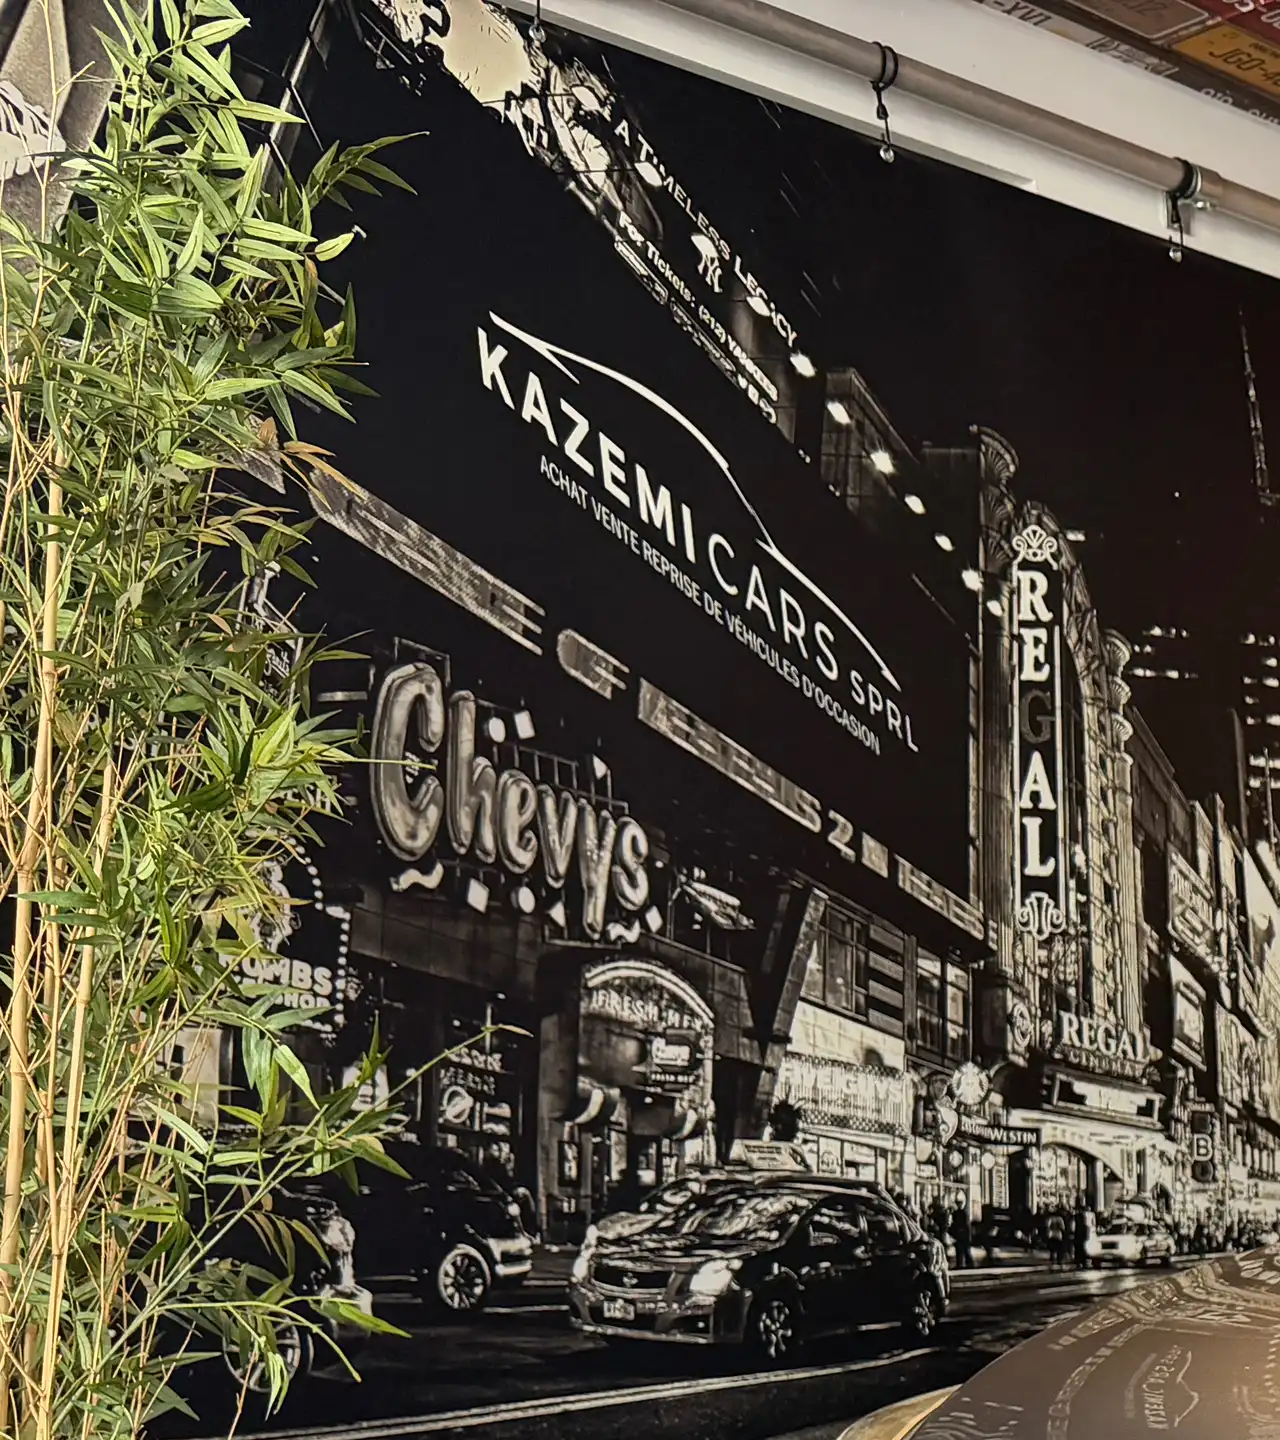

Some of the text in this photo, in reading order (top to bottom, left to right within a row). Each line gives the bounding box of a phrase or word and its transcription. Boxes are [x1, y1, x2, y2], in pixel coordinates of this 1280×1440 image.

[614, 118, 631, 147] A
[477, 326, 696, 564] KAZEMI
[708, 533, 839, 682] CARS
[850, 669, 920, 753] SPRL
[540, 455, 588, 510] ACHAT
[591, 495, 641, 556] VENTE
[642, 536, 702, 605] REPRISE
[703, 590, 725, 625] DE
[802, 678, 881, 756] D'OCCASION
[371, 660, 649, 940] Chevys
[1017, 570, 1057, 878] REGAL
[1059, 1010, 1151, 1064] REGAL
